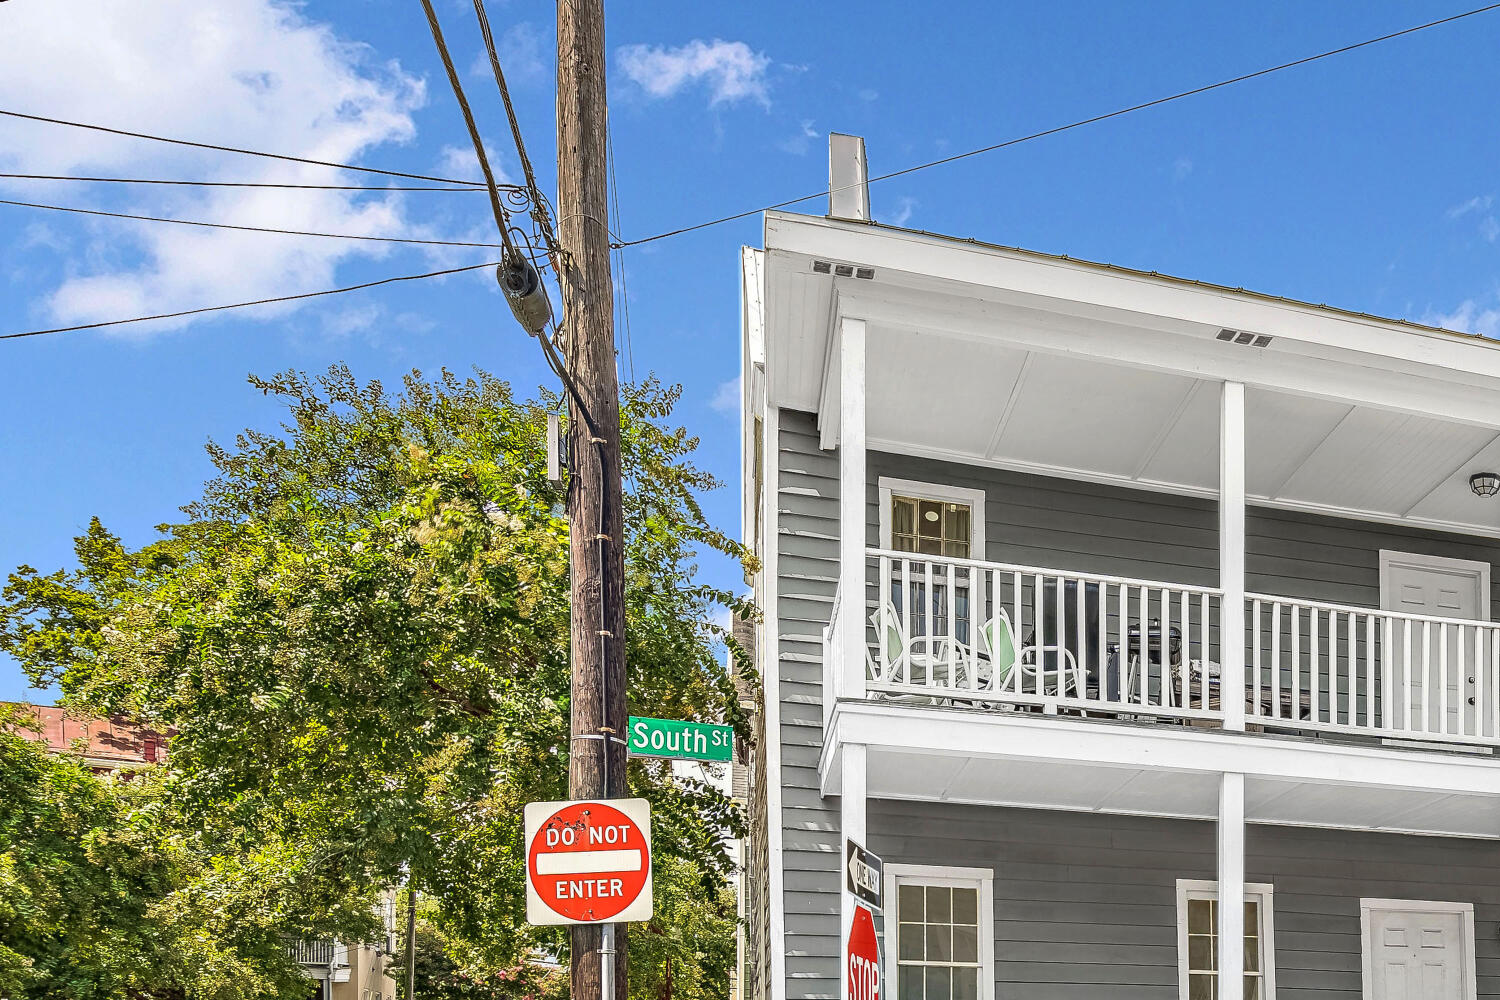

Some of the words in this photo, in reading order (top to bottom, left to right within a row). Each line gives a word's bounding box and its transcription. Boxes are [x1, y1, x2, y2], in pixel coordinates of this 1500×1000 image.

[632, 722, 707, 754] South
[711, 729, 729, 747] St
[546, 827, 575, 847] DO
[589, 825, 631, 845] NOT
[556, 878, 624, 899] ENTER
[857, 861, 867, 886] ONE
[867, 867, 879, 893] WAY
